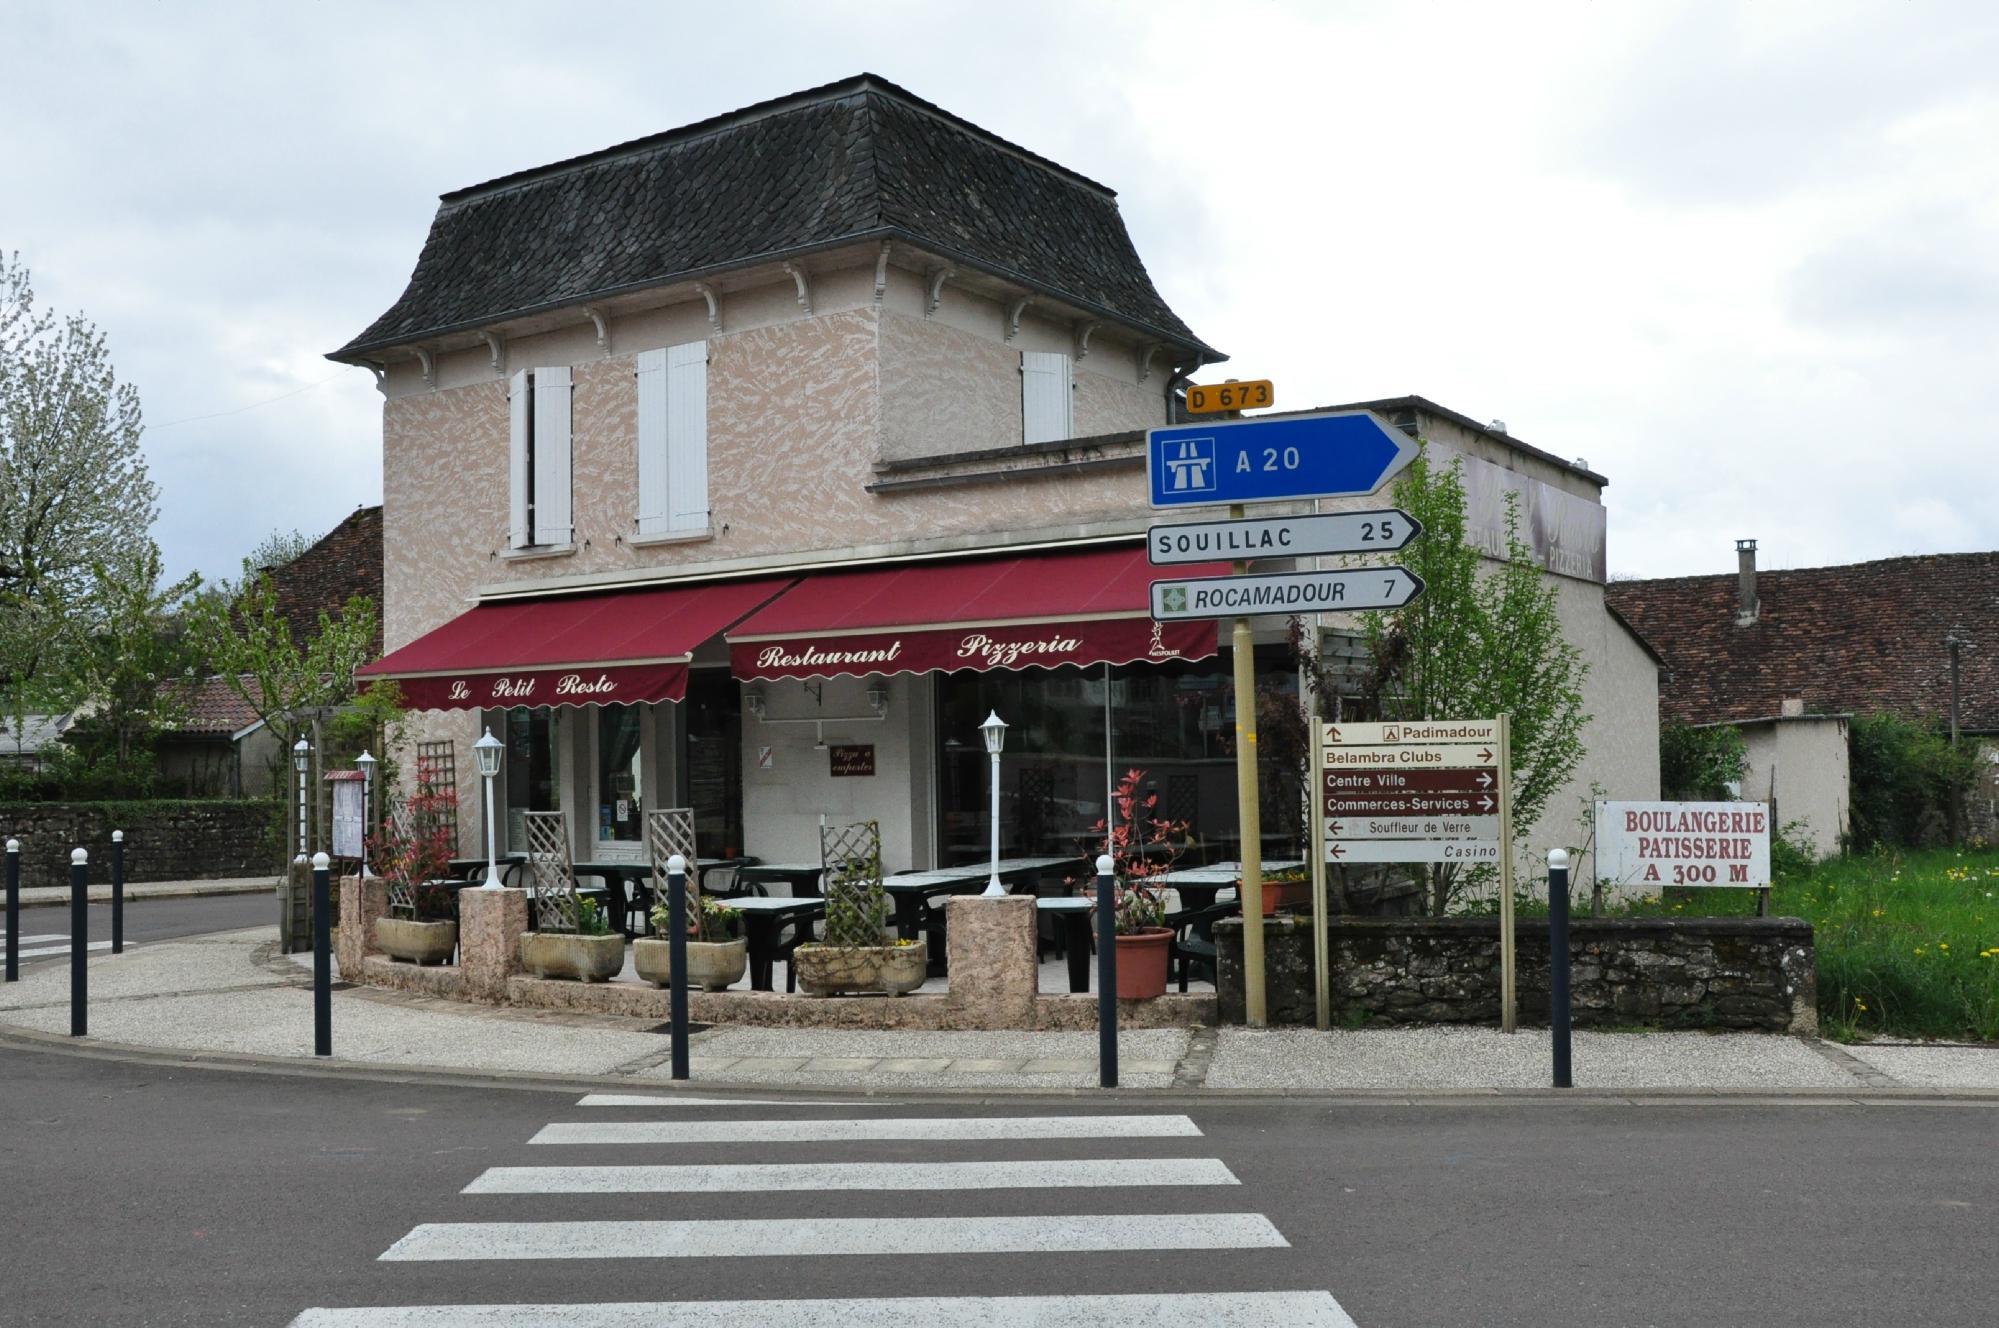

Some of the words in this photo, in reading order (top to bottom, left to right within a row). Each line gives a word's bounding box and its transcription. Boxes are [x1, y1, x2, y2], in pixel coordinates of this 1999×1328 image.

[1192, 390, 1205, 408] D
[1219, 385, 1268, 407] 673
[1236, 450, 1251, 473] A
[1263, 447, 1300, 471] 20
[1159, 527, 1292, 554] SOUILLAC
[1361, 521, 1394, 541] 25
[1549, 546, 1593, 577] PIZZERIA
[1195, 582, 1346, 609] ROCAMADOUR
[1383, 580, 1396, 598] 7
[756, 640, 902, 668] Restaurant
[957, 634, 1085, 666] Pizzeria
[448, 680, 472, 700] Le
[491, 677, 536, 698] Petit
[556, 674, 618, 695] Resto
[1403, 726, 1492, 739] Padimadour
[1326, 752, 1395, 764] Belambra
[1400, 751, 1442, 763] Clubs
[1327, 775, 1371, 787] Centre
[1377, 774, 1406, 786] Ville
[1328, 797, 1470, 811] Commerces-Services
[1369, 821, 1419, 834] Souffleur
[1424, 821, 1436, 833] de
[1442, 821, 1471, 833] Verre
[1625, 811, 1765, 833] BOULANGERIE
[1445, 845, 1496, 857] Casino
[1638, 837, 1752, 860] PATISSERIE
[1643, 863, 1661, 881] A
[1673, 864, 1717, 885] 300
[1729, 864, 1748, 882] M
